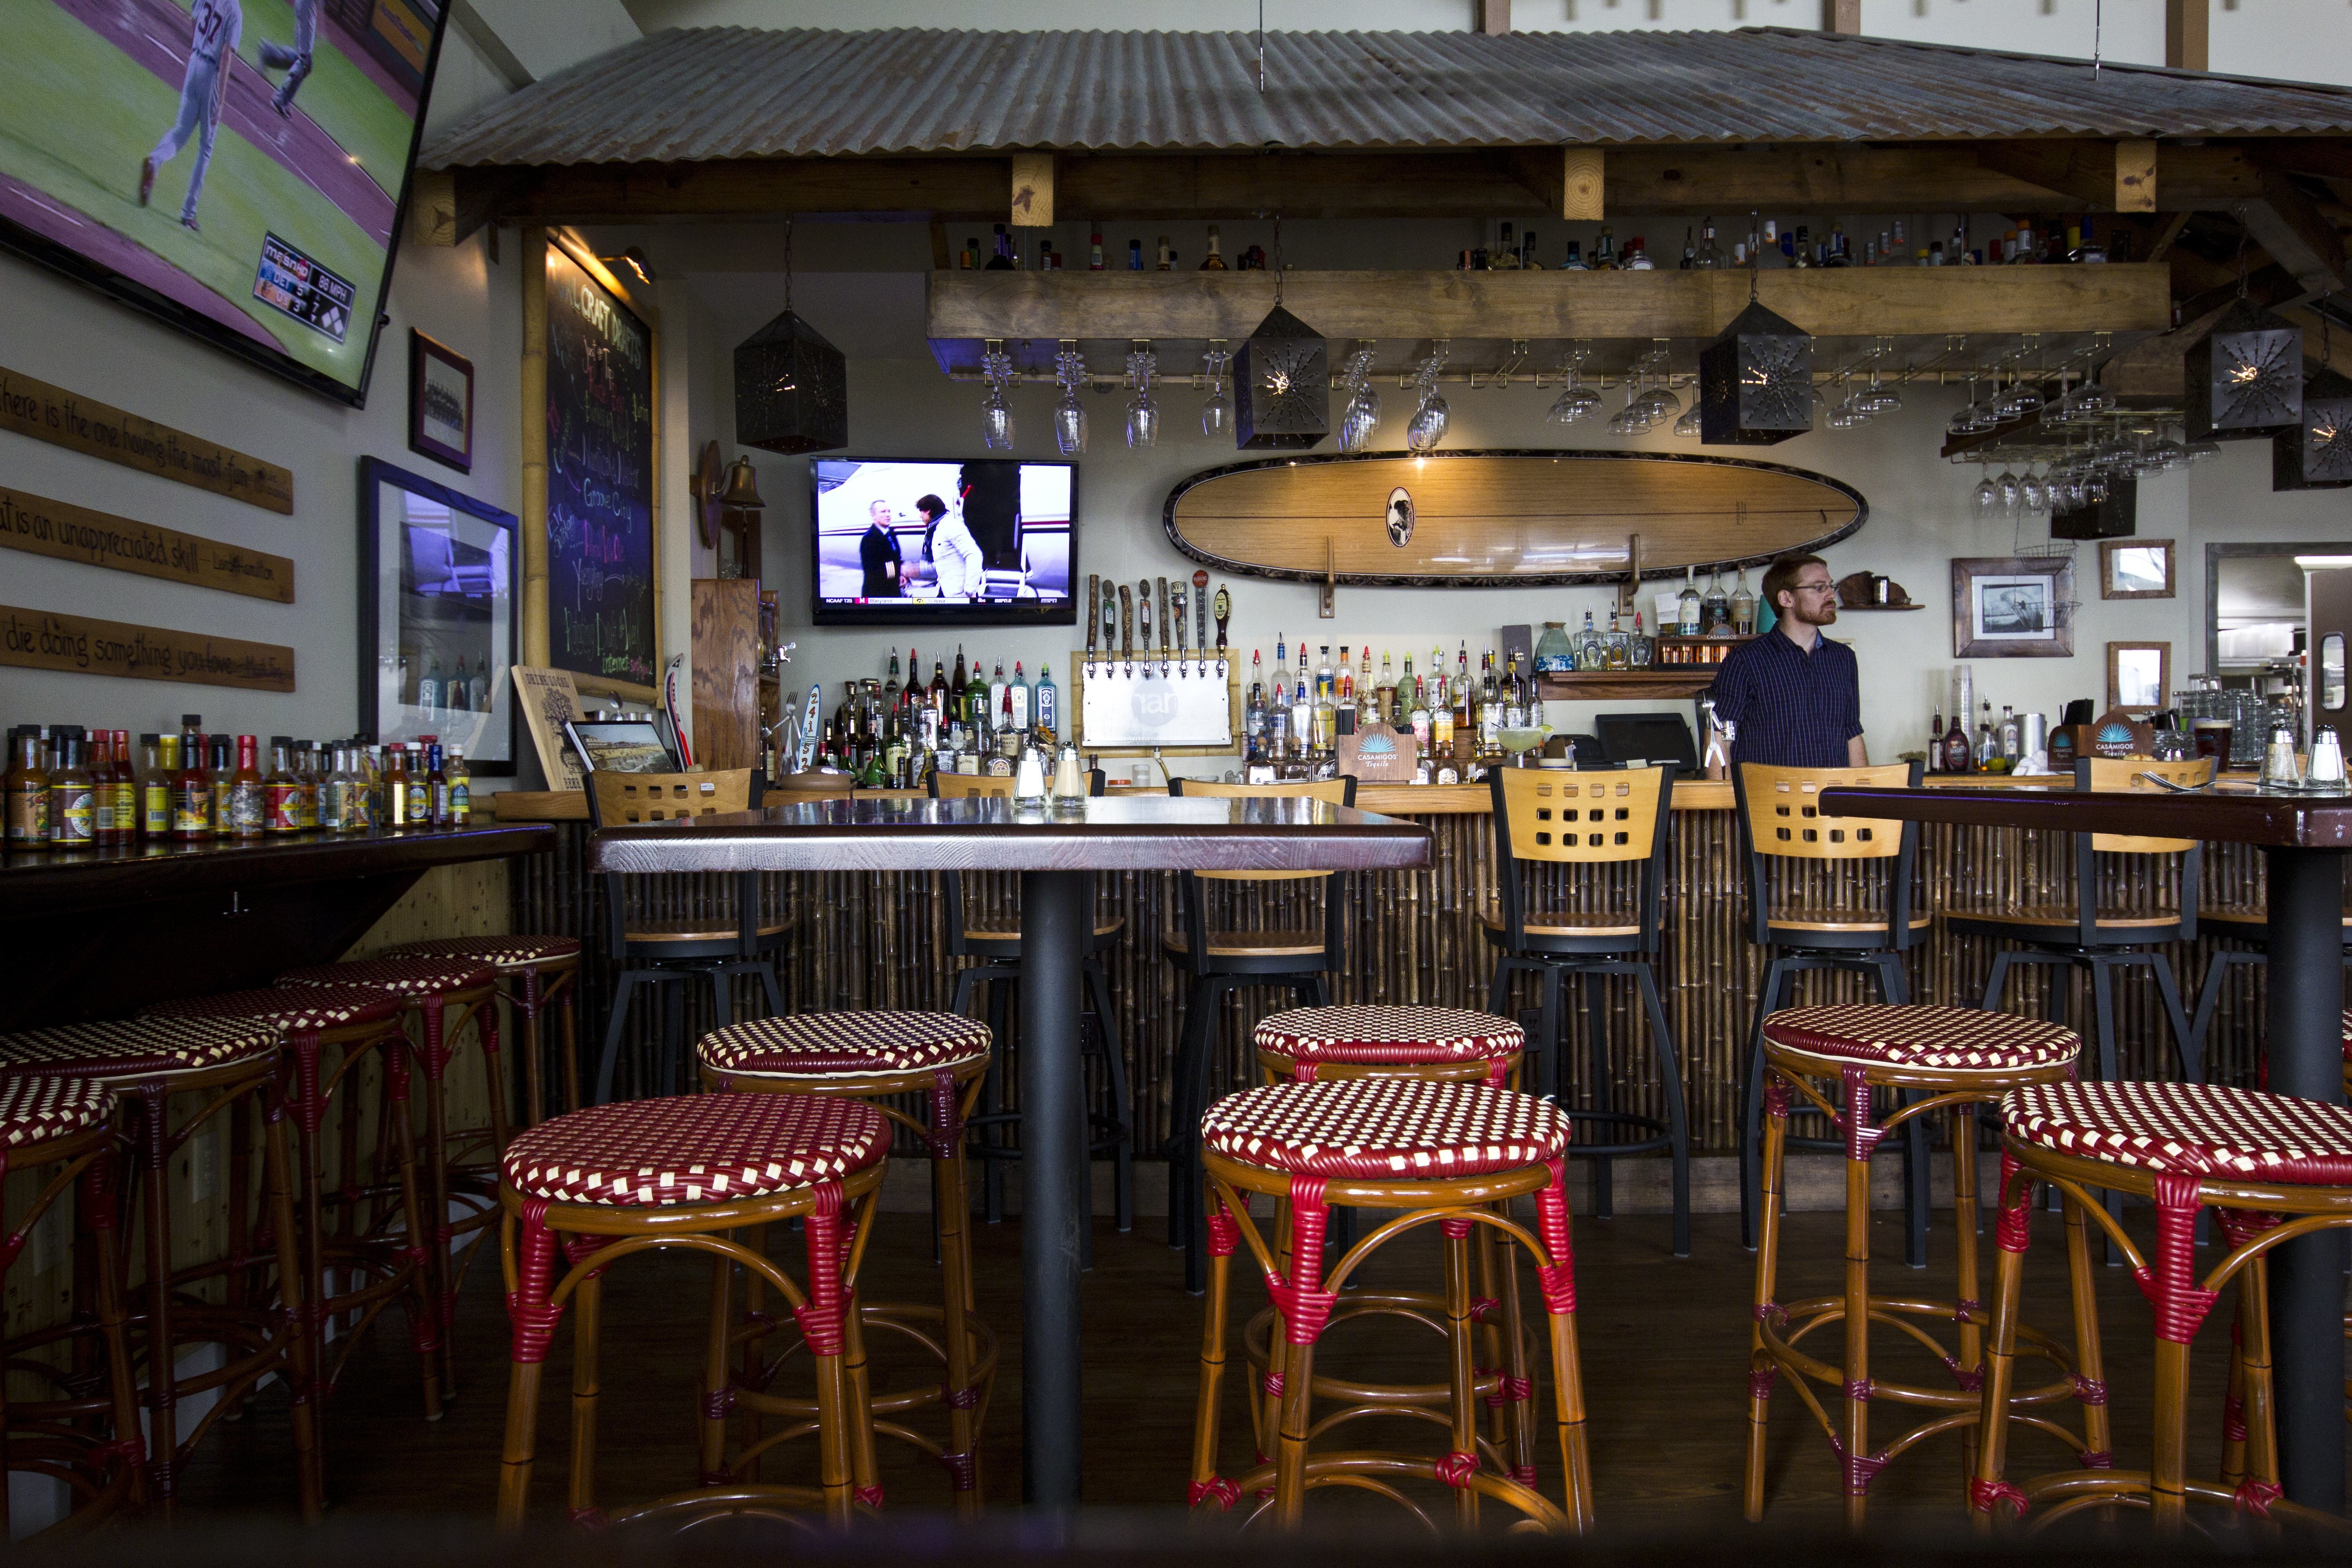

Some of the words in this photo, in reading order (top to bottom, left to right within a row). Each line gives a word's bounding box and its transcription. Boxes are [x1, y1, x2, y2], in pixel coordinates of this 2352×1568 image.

[198, 2, 222, 44] 37
[274, 273, 289, 290] DET
[329, 281, 347, 301] MPH
[293, 302, 300, 312] 3
[313, 302, 319, 313] 7
[581, 284, 610, 340] CRAFT
[0, 377, 37, 421] here
[45, 399, 59, 428] is
[64, 399, 88, 439] the
[93, 421, 119, 447] one
[122, 418, 165, 468] having
[167, 435, 187, 470] the
[191, 451, 221, 479] most
[583, 477, 612, 509] Groove
[612, 490, 632, 534] City
[15, 505, 30, 534] is
[33, 515, 54, 541] an
[58, 521, 168, 565] unappreciated
[172, 537, 198, 574] skill
[1122, 588, 1132, 631] BURLEY
[6, 614, 36, 654] die
[40, 616, 89, 668] doing
[94, 632, 172, 676] something
[177, 650, 203, 676] you
[525, 673, 549, 686] DRINK
[548, 676, 569, 688] LOCAL
[563, 777, 582, 789] BEER
